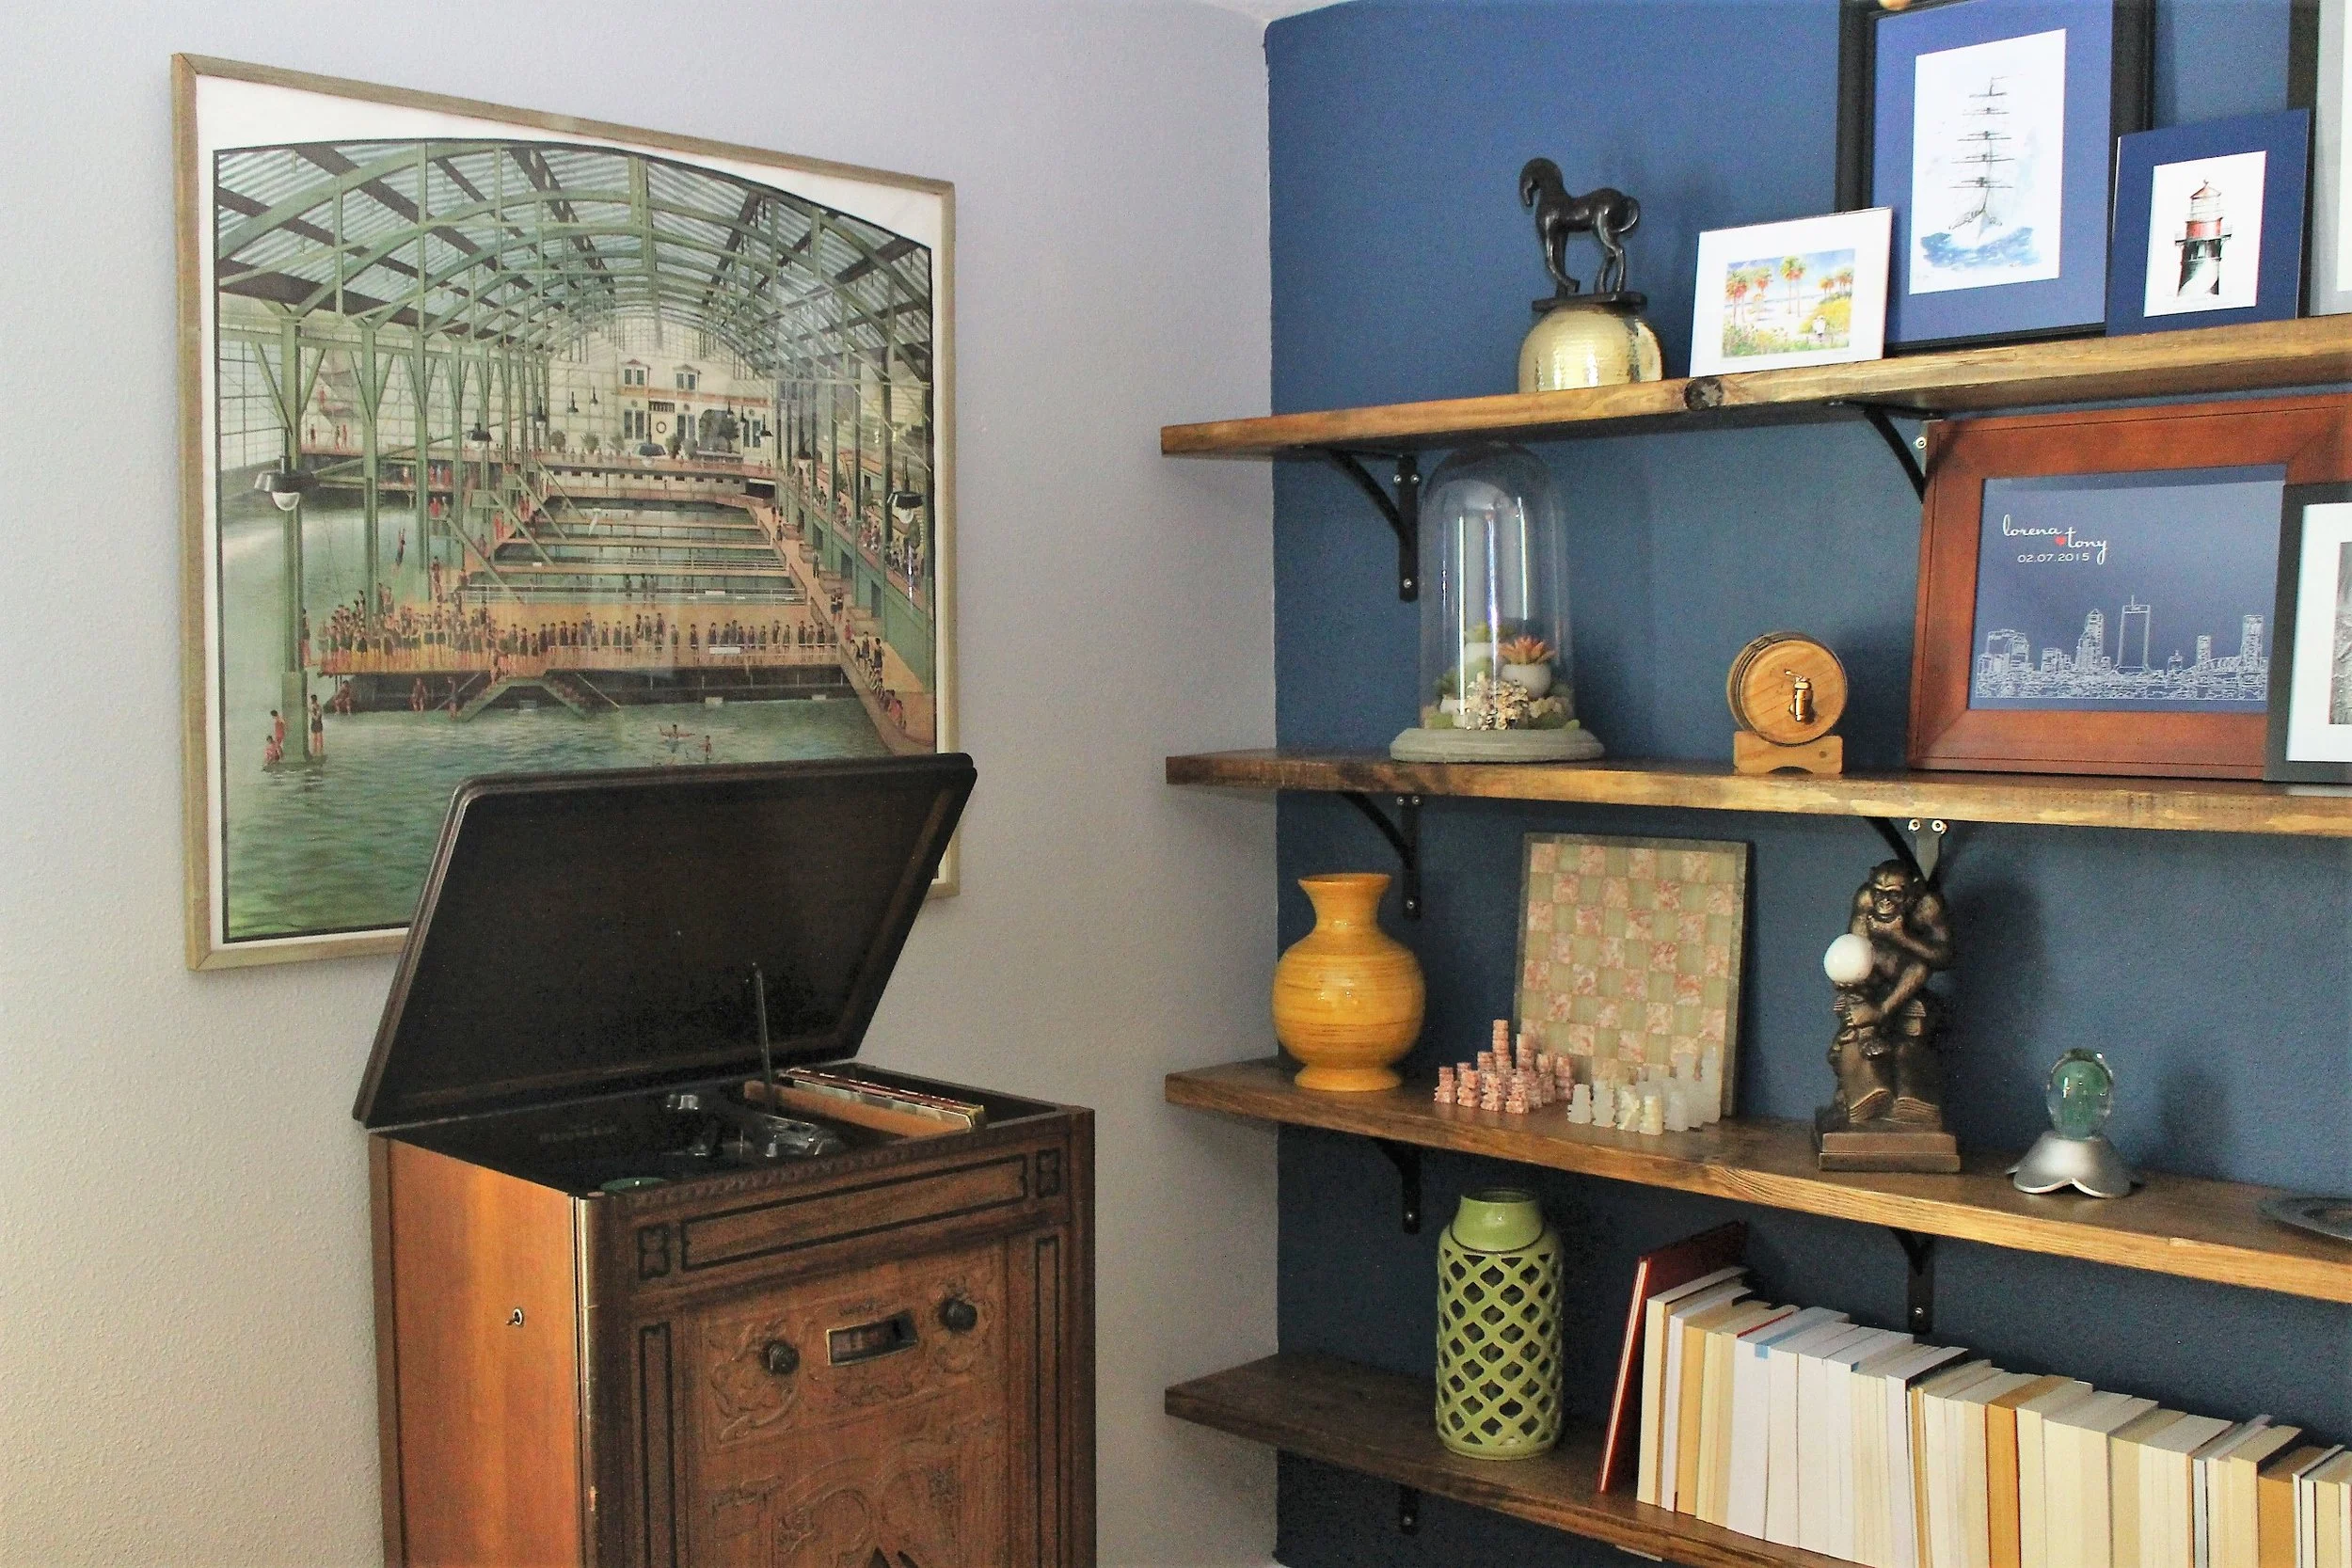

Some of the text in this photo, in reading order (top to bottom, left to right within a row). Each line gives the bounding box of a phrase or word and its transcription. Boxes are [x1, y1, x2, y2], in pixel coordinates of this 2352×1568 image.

[2002, 514, 2062, 537] lorena
[2065, 527, 2107, 565] tony
[2017, 553, 2090, 563] 02.07.2015
